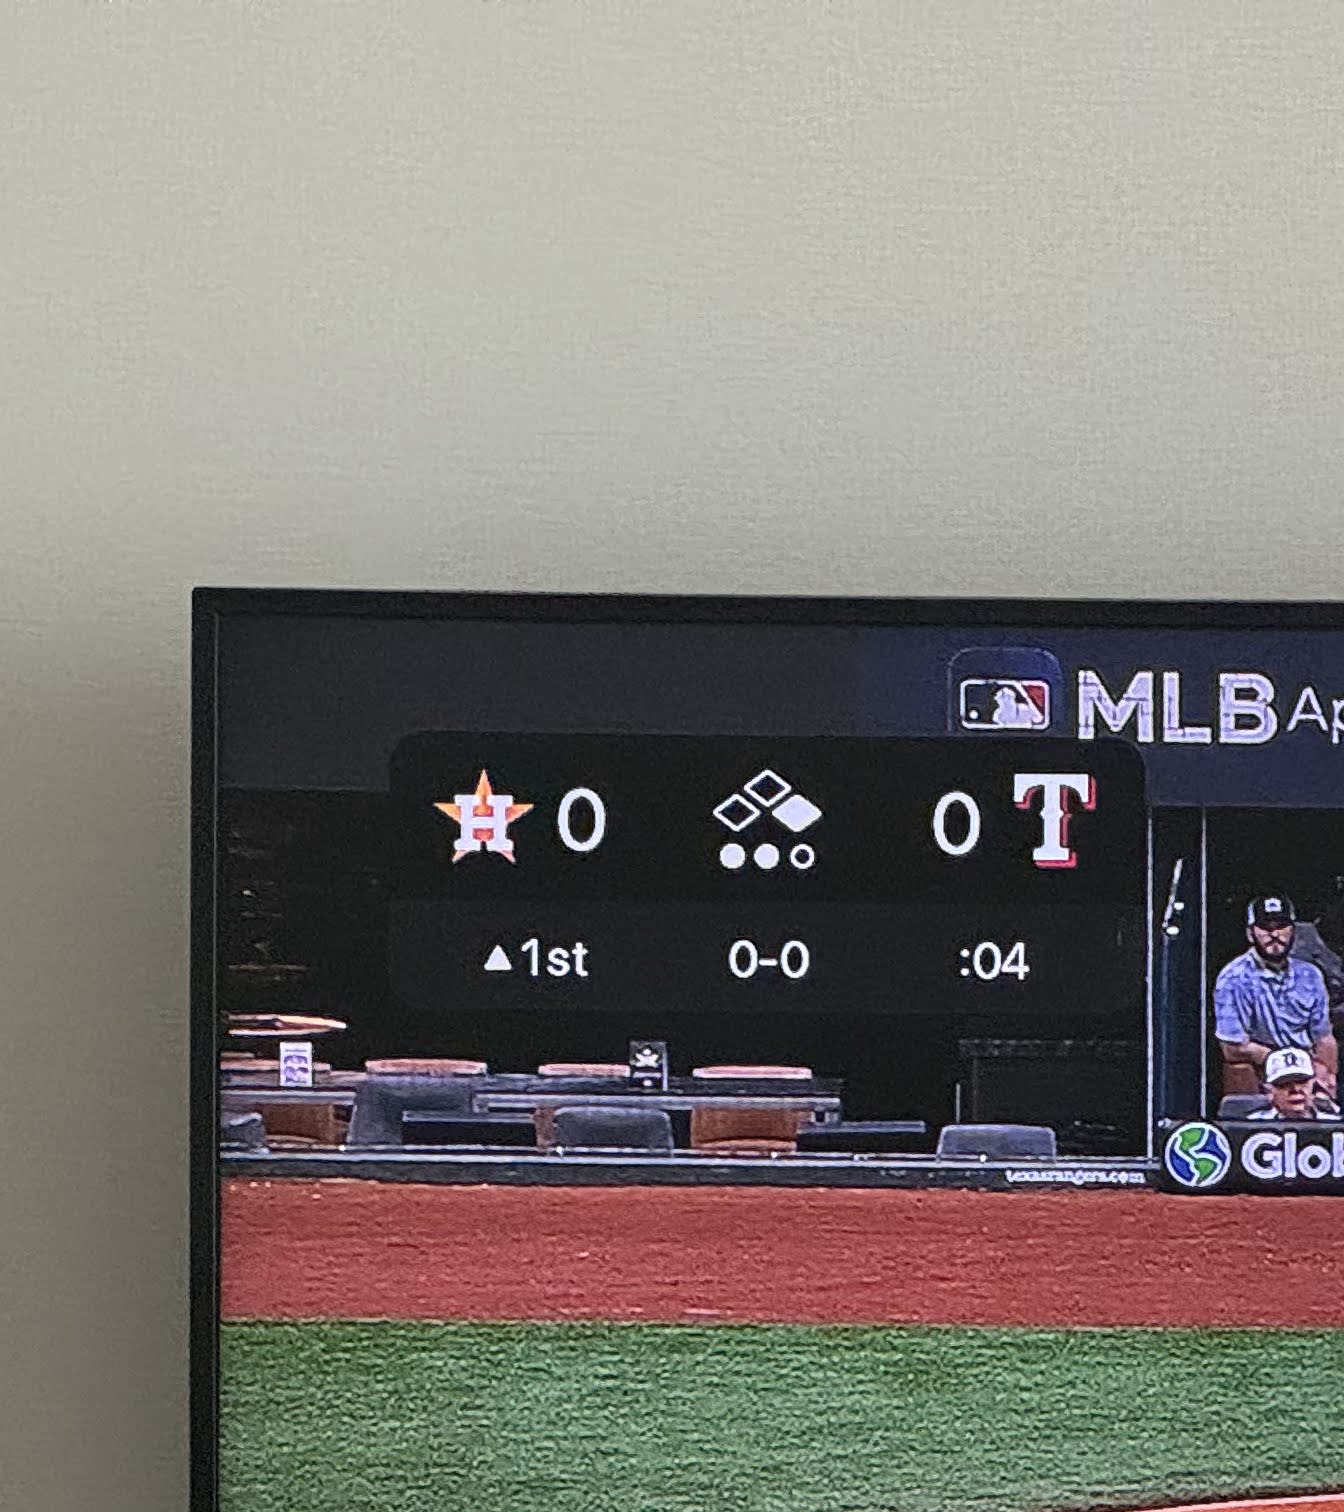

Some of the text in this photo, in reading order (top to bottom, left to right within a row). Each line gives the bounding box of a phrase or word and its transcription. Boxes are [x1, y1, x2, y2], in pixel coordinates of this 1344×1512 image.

[1077, 669, 1280, 744] MLB
[557, 787, 606, 852] 0
[932, 790, 981, 856] 0
[521, 938, 590, 977] 1st
[728, 939, 810, 979] 0-0
[960, 941, 1030, 981] :04
